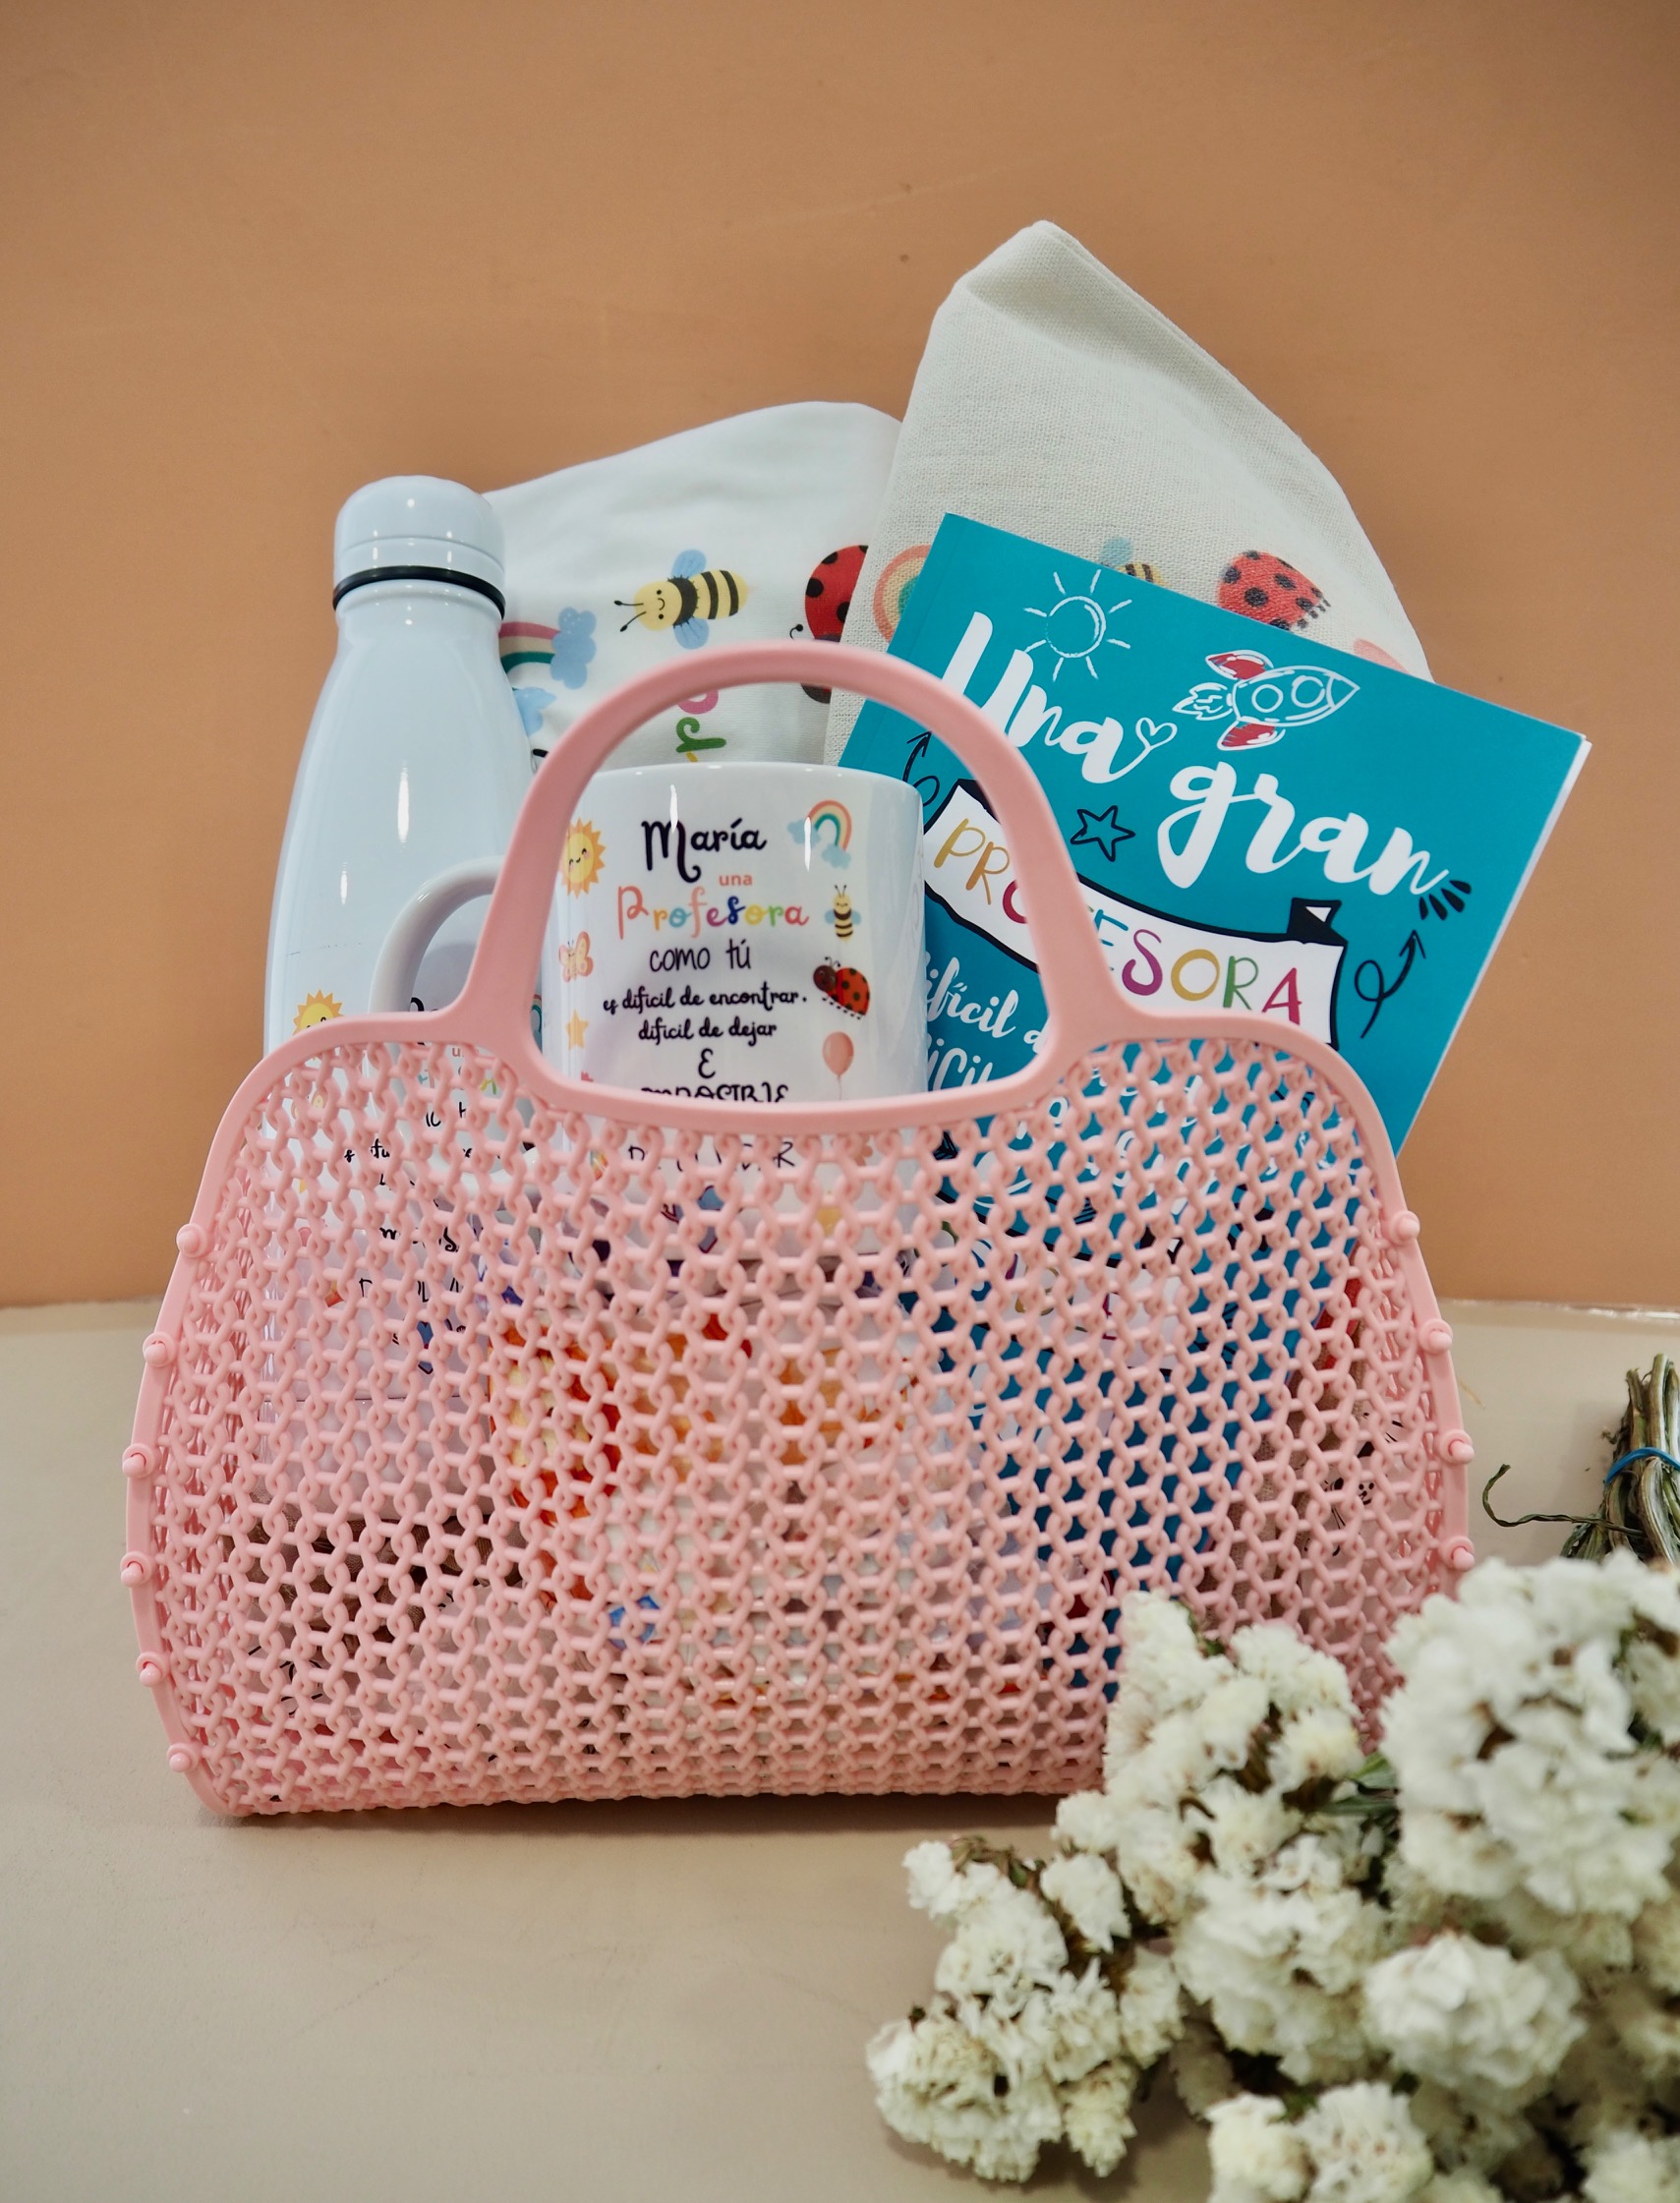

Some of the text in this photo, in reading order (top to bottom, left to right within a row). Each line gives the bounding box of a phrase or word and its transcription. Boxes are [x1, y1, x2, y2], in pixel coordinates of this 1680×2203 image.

[940, 610, 1178, 784] Una
[641, 817, 768, 883] María
[1157, 760, 1450, 897] gran
[718, 873, 753, 886] una
[617, 885, 810, 941] Profesora
[933, 818, 1303, 1025] PRESORA
[649, 938, 751, 973] como tú
[679, 984, 705, 1007] de
[698, 1015, 724, 1038] de
[728, 1015, 778, 1047] dejar
